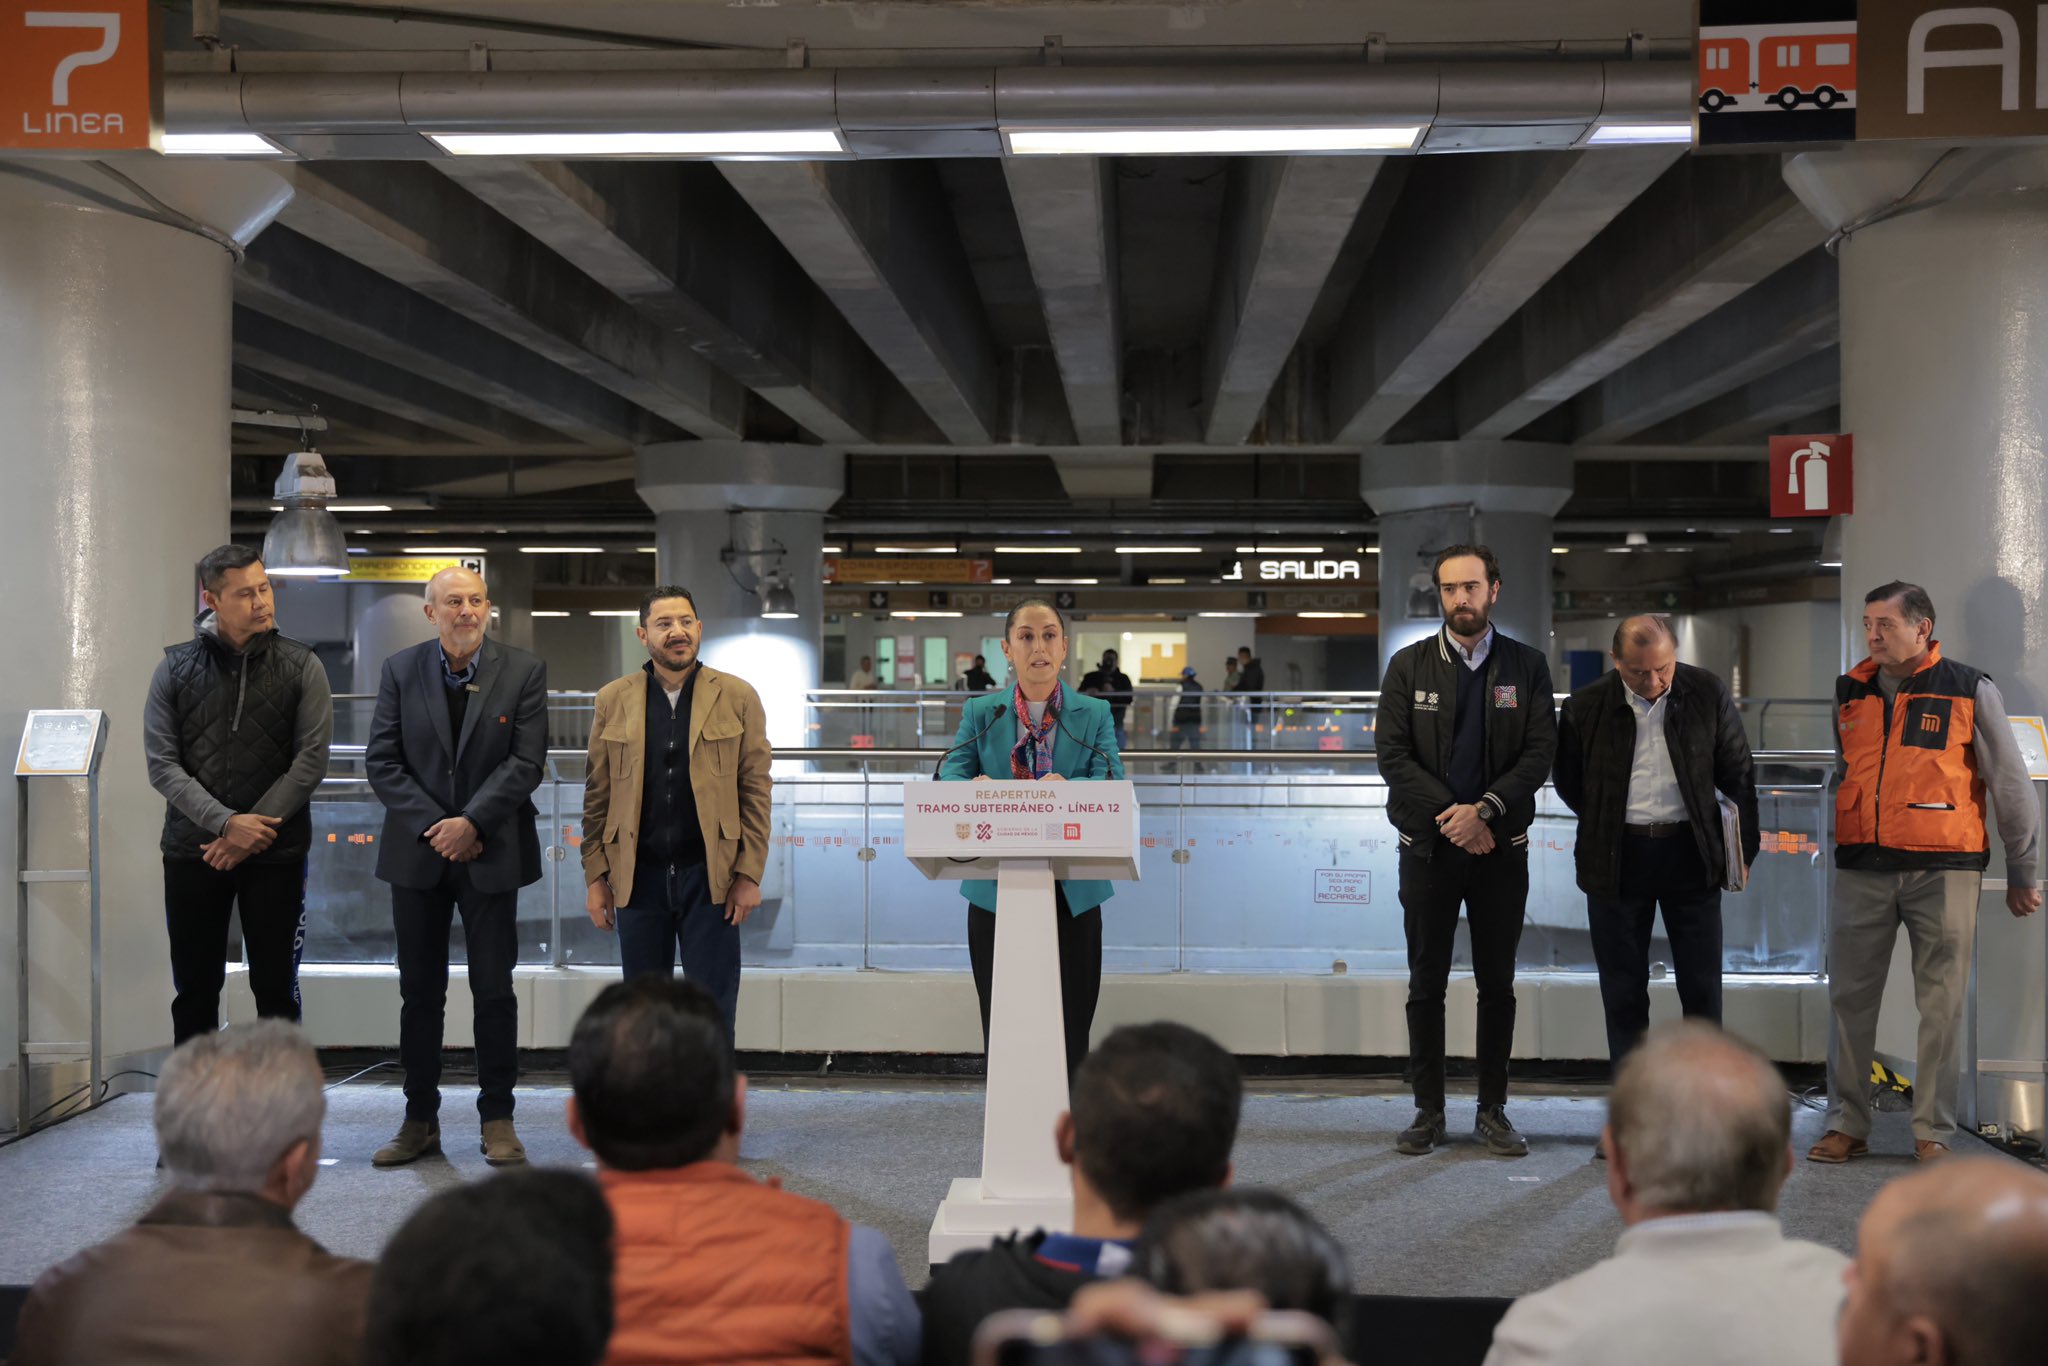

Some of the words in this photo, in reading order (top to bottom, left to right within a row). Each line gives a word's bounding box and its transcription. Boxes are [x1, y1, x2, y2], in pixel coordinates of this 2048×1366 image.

[25, 11, 121, 106] 7
[1906, 4, 2048, 114] A
[23, 112, 124, 134] LINEA
[975, 560, 989, 578] 7
[1260, 560, 1360, 579] SALIDA
[951, 593, 984, 608] NO
[1284, 593, 1360, 608] SALIDA
[975, 790, 1057, 800] REAPERTURA
[916, 803, 961, 813] TRAMO
[963, 802, 1055, 813] SUBTERRÁNEO
[1068, 802, 1105, 813] LÍNEA
[1108, 803, 1120, 813] 12
[1318, 893, 1367, 901] RECARGUE
